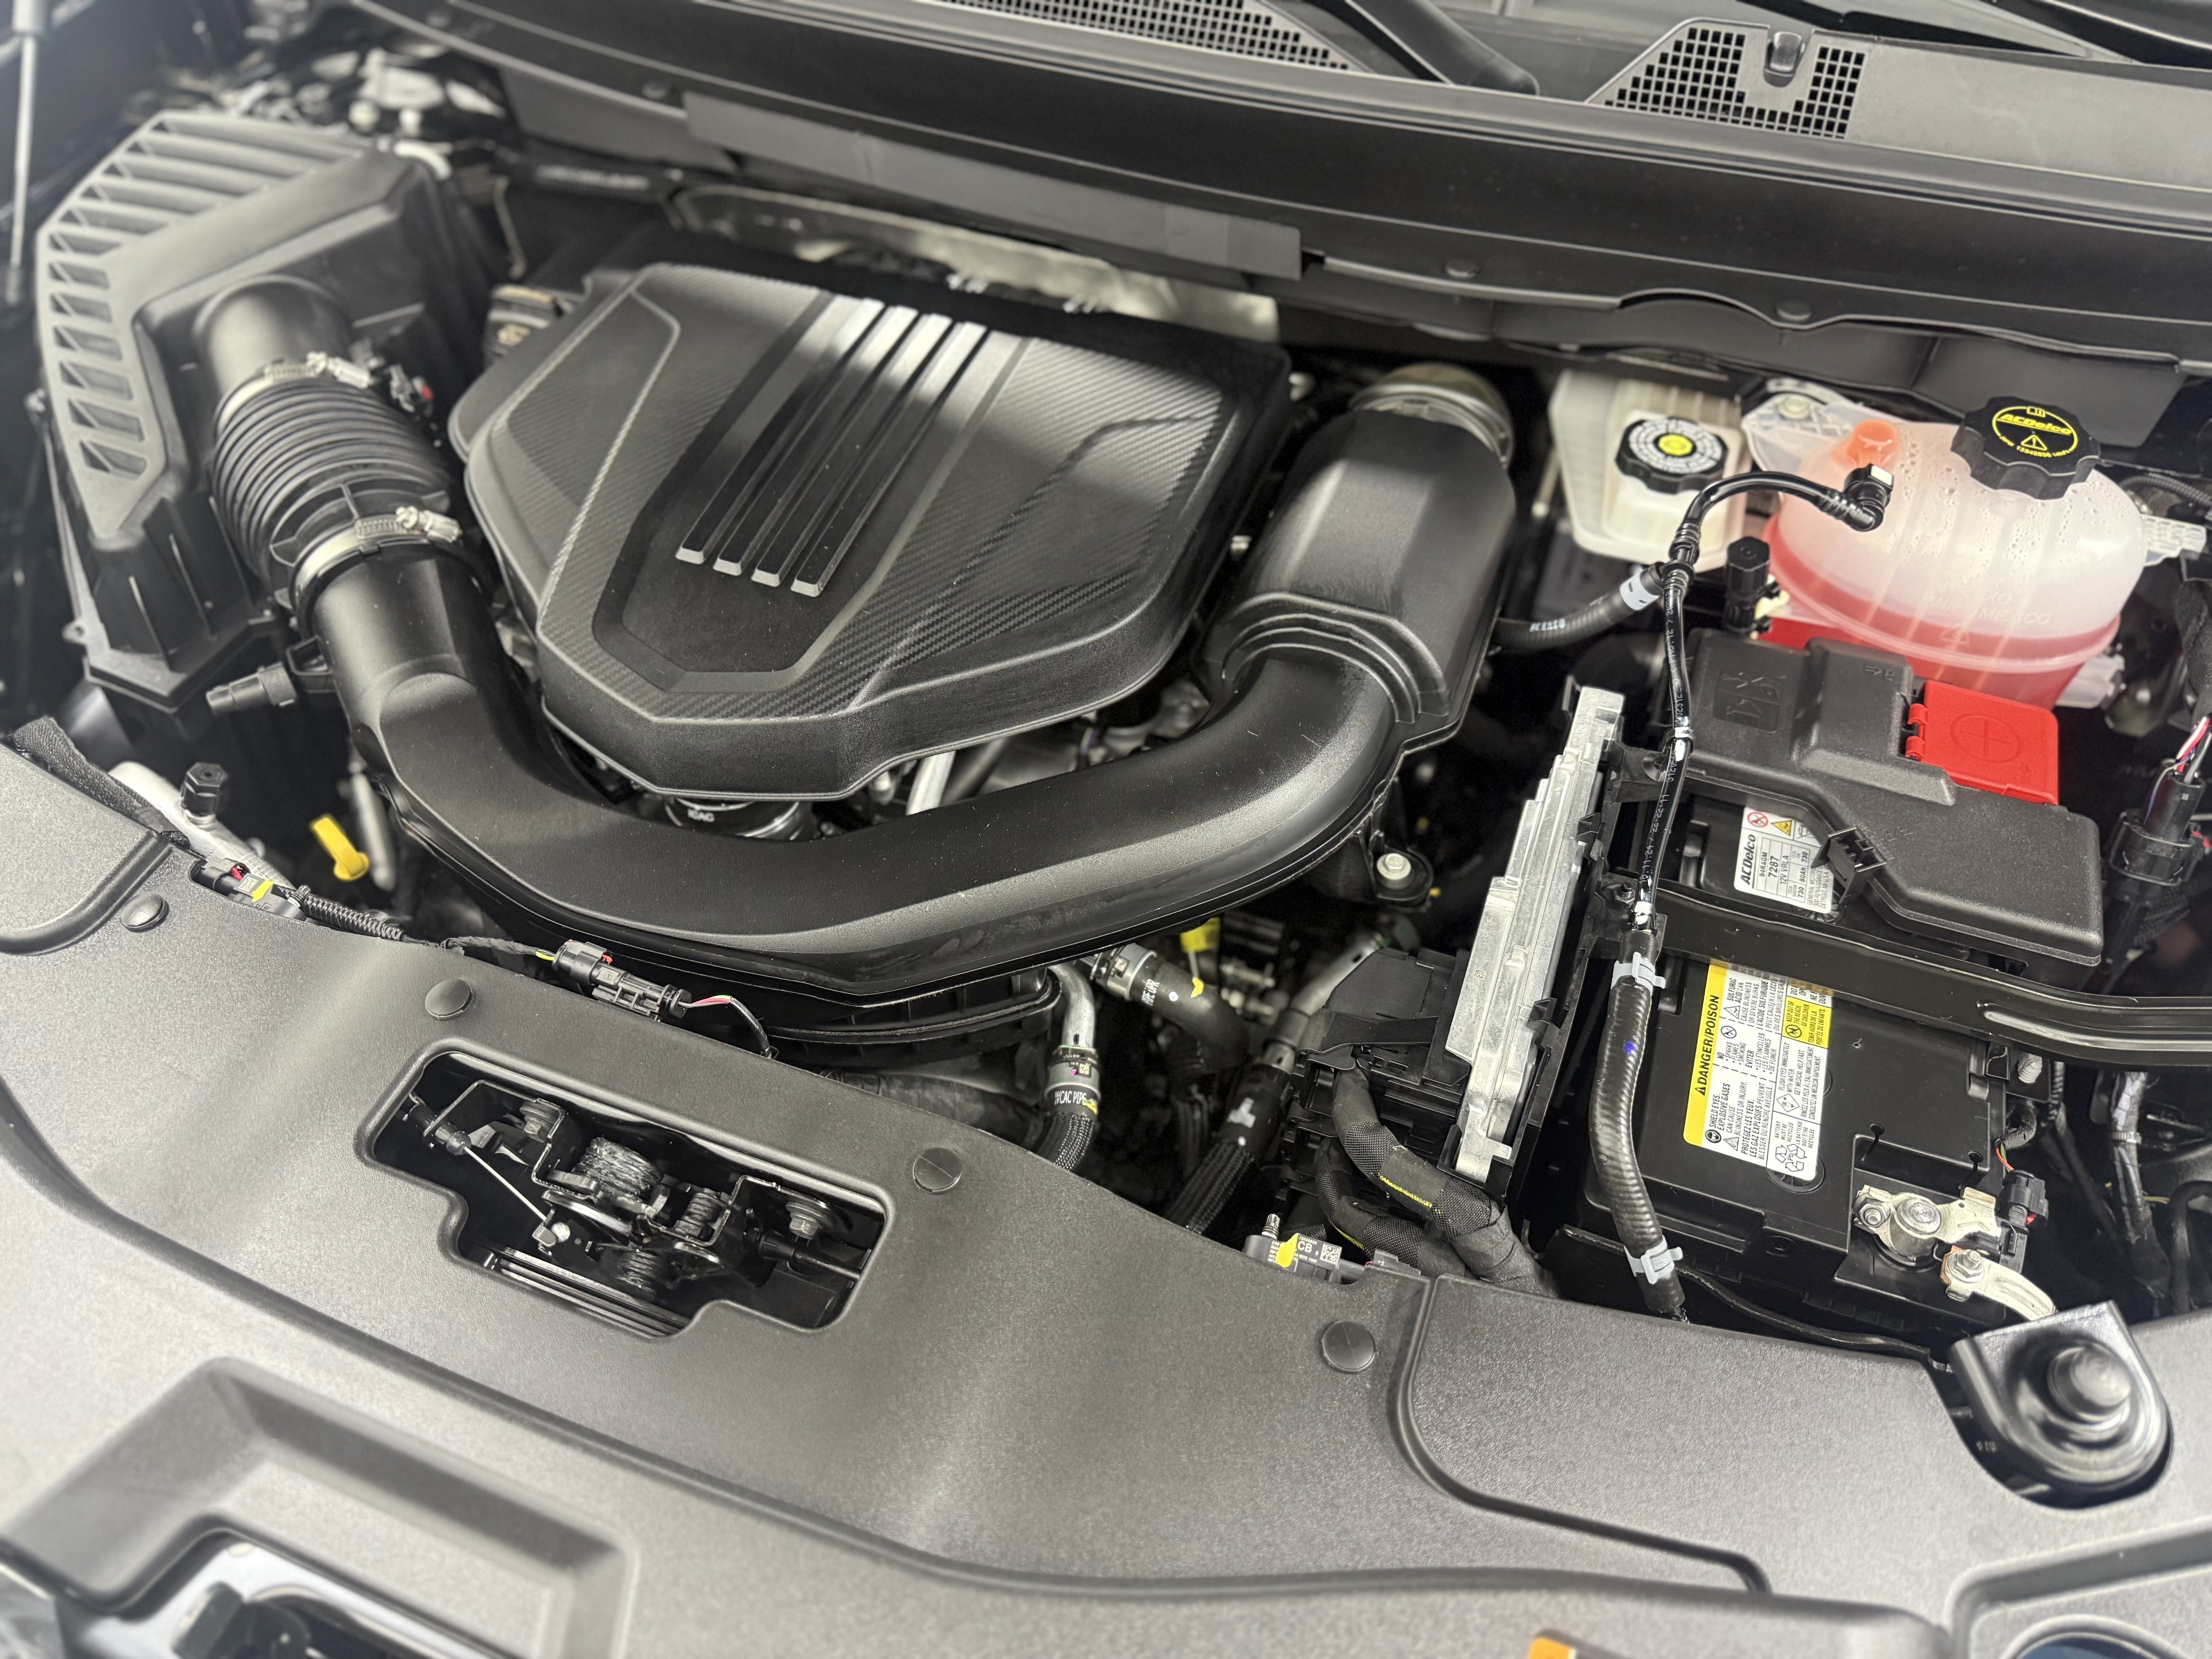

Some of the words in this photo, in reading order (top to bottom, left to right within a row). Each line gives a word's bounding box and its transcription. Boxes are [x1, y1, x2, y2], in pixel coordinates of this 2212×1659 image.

[1999, 414, 2072, 435] ACDelco
[1978, 607, 2052, 625] MEICO
[1740, 833, 1757, 886] ACDelco
[1759, 852, 1767, 877] 94RAGM
[1768, 855, 1779, 878] 7287
[1780, 854, 1789, 872] VRLA
[1814, 869, 1822, 898] RENAISSANCE
[1819, 889, 1828, 908] DETROIT,
[1727, 977, 1736, 1001] SULFURIC
[1734, 991, 1742, 1003] ACID
[1743, 981, 1752, 1006] BLINDNESS
[1758, 980, 1769, 1008] SULFURIQUE
[1756, 1008, 1764, 1026] L'ACIDE
[1767, 998, 1775, 1016] CAUSER
[1697, 994, 1719, 1085] DANGER/POISON
[1762, 1038, 1771, 1060] FLAMMES
[1717, 1051, 1724, 1060] NO
[1738, 1042, 1746, 1062] SMOKING
[1743, 1049, 1754, 1068] ÉVITER
[1781, 1042, 1790, 1067] IMMEDIATELY
[1711, 1092, 1720, 1109] EYES.
[1721, 1082, 1730, 1101] GASES
[1738, 1080, 1747, 1100] INJURY.
[1756, 1082, 1765, 1105] PEUVENT
[1764, 1084, 1773, 1108] AVEUGLE.
[1709, 1109, 1718, 1128] SHIELD
[1717, 1101, 1728, 1130] EXPLOSIVE
[1727, 1105, 1735, 1122] CAUSE
[1752, 1104, 1762, 1134] EXPLOSIFS
[1761, 1108, 1770, 1128] RENDRE
[1808, 1099, 1817, 1120] CONSULTEZ
[1734, 1108, 1743, 1135] BLINDNESS
[1738, 1125, 1751, 1154] PROTÉGEZ
[1745, 1098, 1755, 1115] YEUX.
[1750, 1134, 1759, 1146] GAZ
[1758, 1137, 1766, 1160] BLESSER
[1787, 1152, 1794, 1161] Pb
[1297, 1240, 1313, 1253] CB
